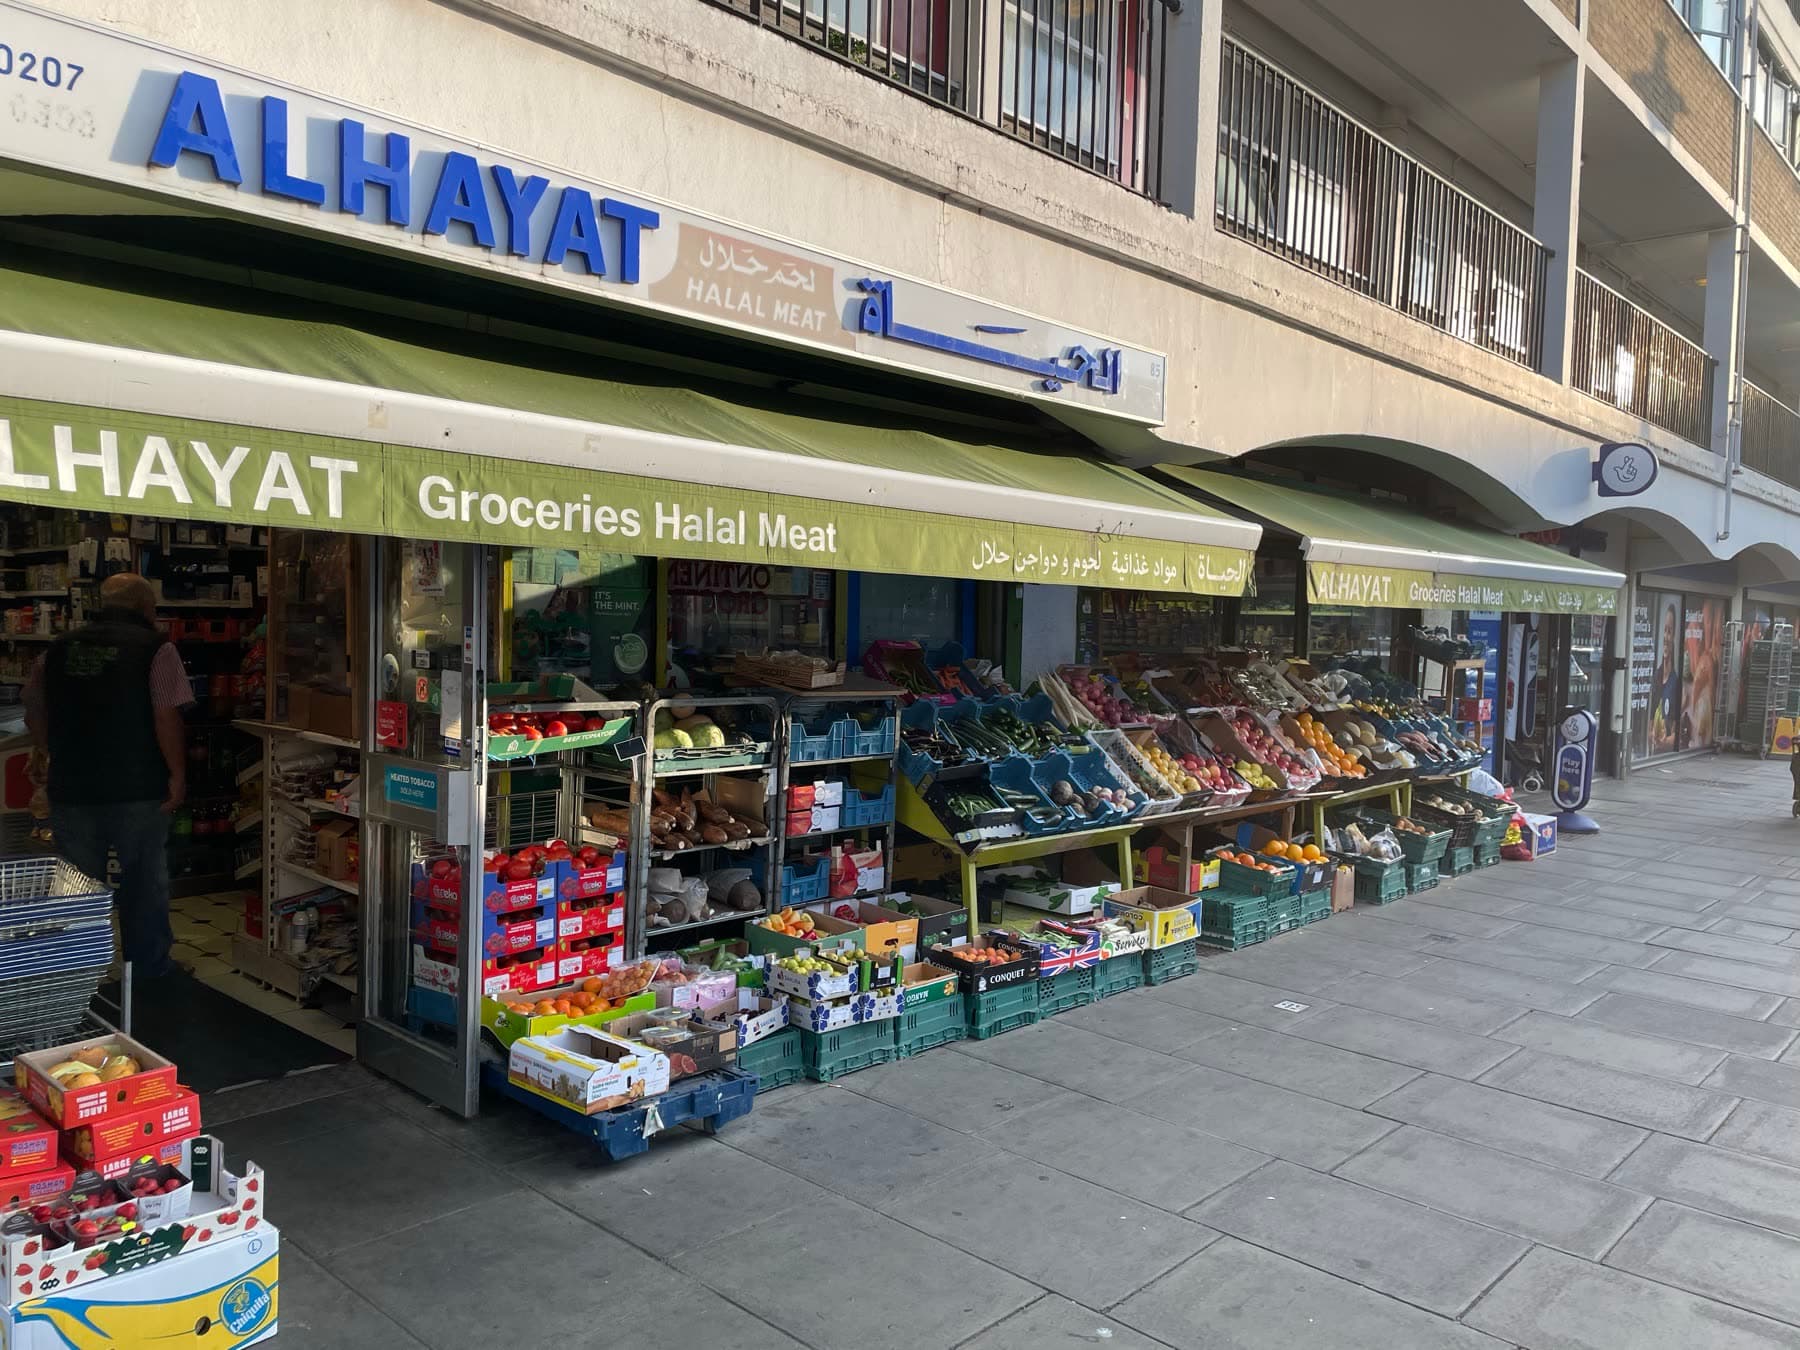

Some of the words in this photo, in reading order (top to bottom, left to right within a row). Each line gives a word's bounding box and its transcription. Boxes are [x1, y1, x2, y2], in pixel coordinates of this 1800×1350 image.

[0, 43, 84, 91] 0207
[148, 70, 660, 284] ALHAYAT
[686, 276, 766, 319] HALAL
[773, 299, 827, 332] MEAT
[418, 475, 641, 537] Groceries
[655, 501, 746, 546] Halal
[758, 511, 838, 553] Meat
[971, 540, 1010, 570] حلال
[1014, 544, 1058, 576] دواجن
[1111, 550, 1149, 582] غذائية
[1153, 556, 1177, 584] مواد
[594, 591, 611, 601] IT'S
[1318, 571, 1391, 603] ALHAYAT
[1410, 583, 1457, 604] Groceries
[1458, 585, 1481, 606] Halal
[1483, 588, 1504, 606] Meat
[594, 601, 613, 611] THE
[562, 735, 582, 744] BEEF
[582, 728, 618, 740] TOMATOES
[390, 772, 410, 784] HEATED
[410, 775, 435, 790] TOBACCO
[1562, 767, 1580, 775] here
[989, 968, 1025, 985] CONQUET
[906, 990, 929, 1003] MANGO
[78, 1103, 108, 1119] LARGE
[162, 1106, 189, 1121] LARGE
[103, 1157, 131, 1174] LARGE
[230, 1292, 270, 1334] Chiquita
